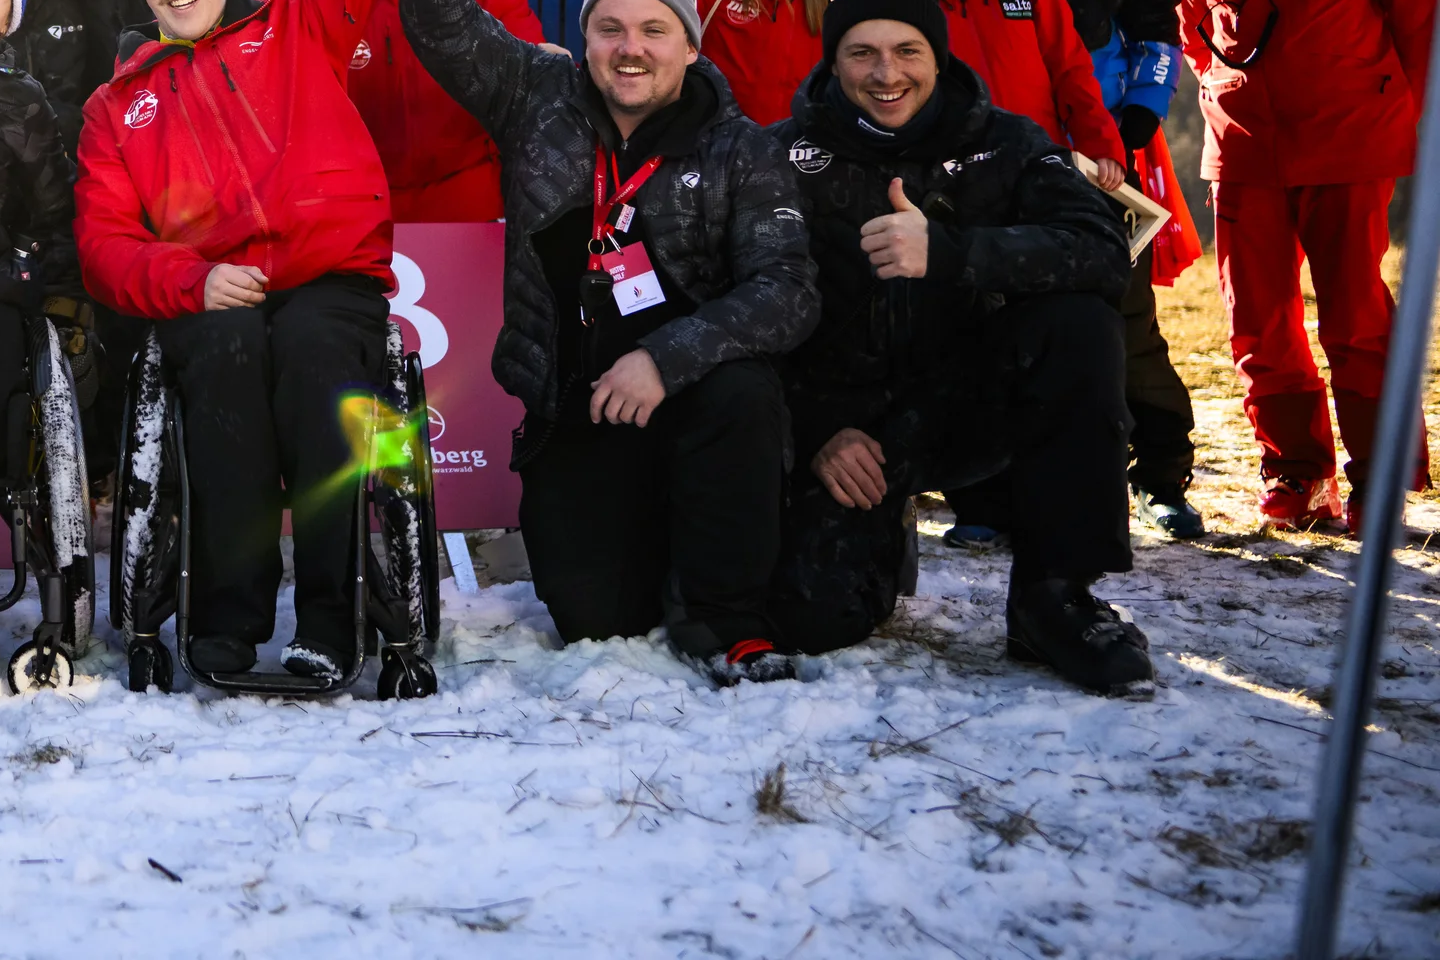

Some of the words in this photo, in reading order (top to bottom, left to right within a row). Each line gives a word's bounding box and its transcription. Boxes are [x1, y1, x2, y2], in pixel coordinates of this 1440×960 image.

[353, 48, 372, 59] PS
[123, 92, 159, 125] DPS
[432, 446, 488, 468] berg
